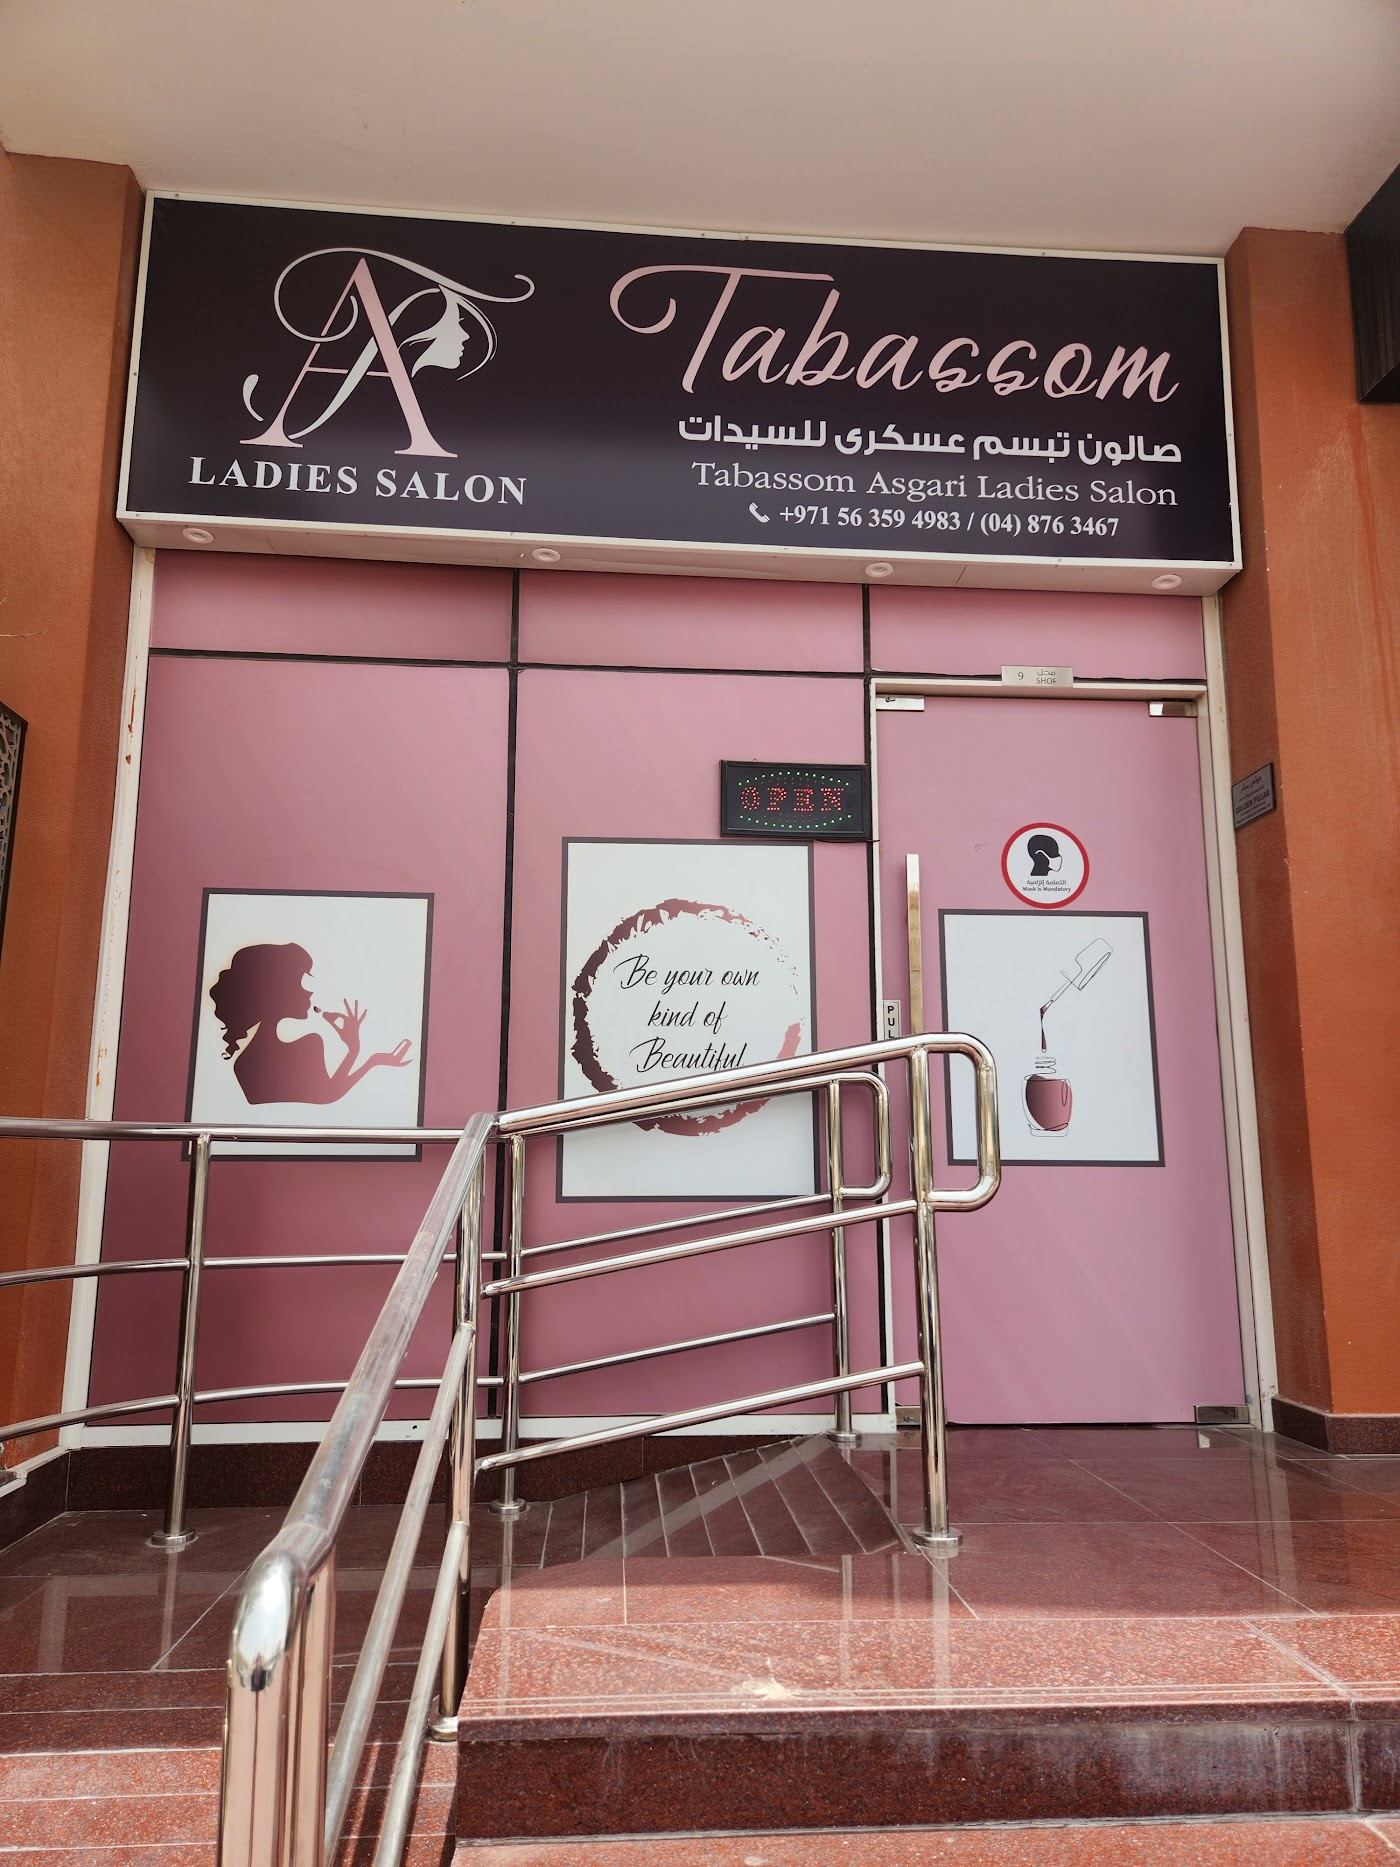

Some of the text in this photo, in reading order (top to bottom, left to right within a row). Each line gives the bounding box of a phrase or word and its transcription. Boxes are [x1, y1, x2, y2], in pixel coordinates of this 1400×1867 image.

[609, 264, 1180, 404] Tabassom
[678, 414, 827, 451] للسيدات
[973, 431, 1070, 464] تبسم
[1077, 432, 1182, 466] صالون
[188, 455, 528, 506] LADIES SALON
[691, 461, 1179, 506] Tabassom Asgari Ladies Salon
[779, 504, 1120, 538] +971 56 359 4983 / (04) 876 3467
[740, 786, 844, 812] OPEN
[612, 953, 761, 995] Be your own
[647, 1000, 728, 1035] kind of
[628, 1036, 748, 1073] Beautiful
